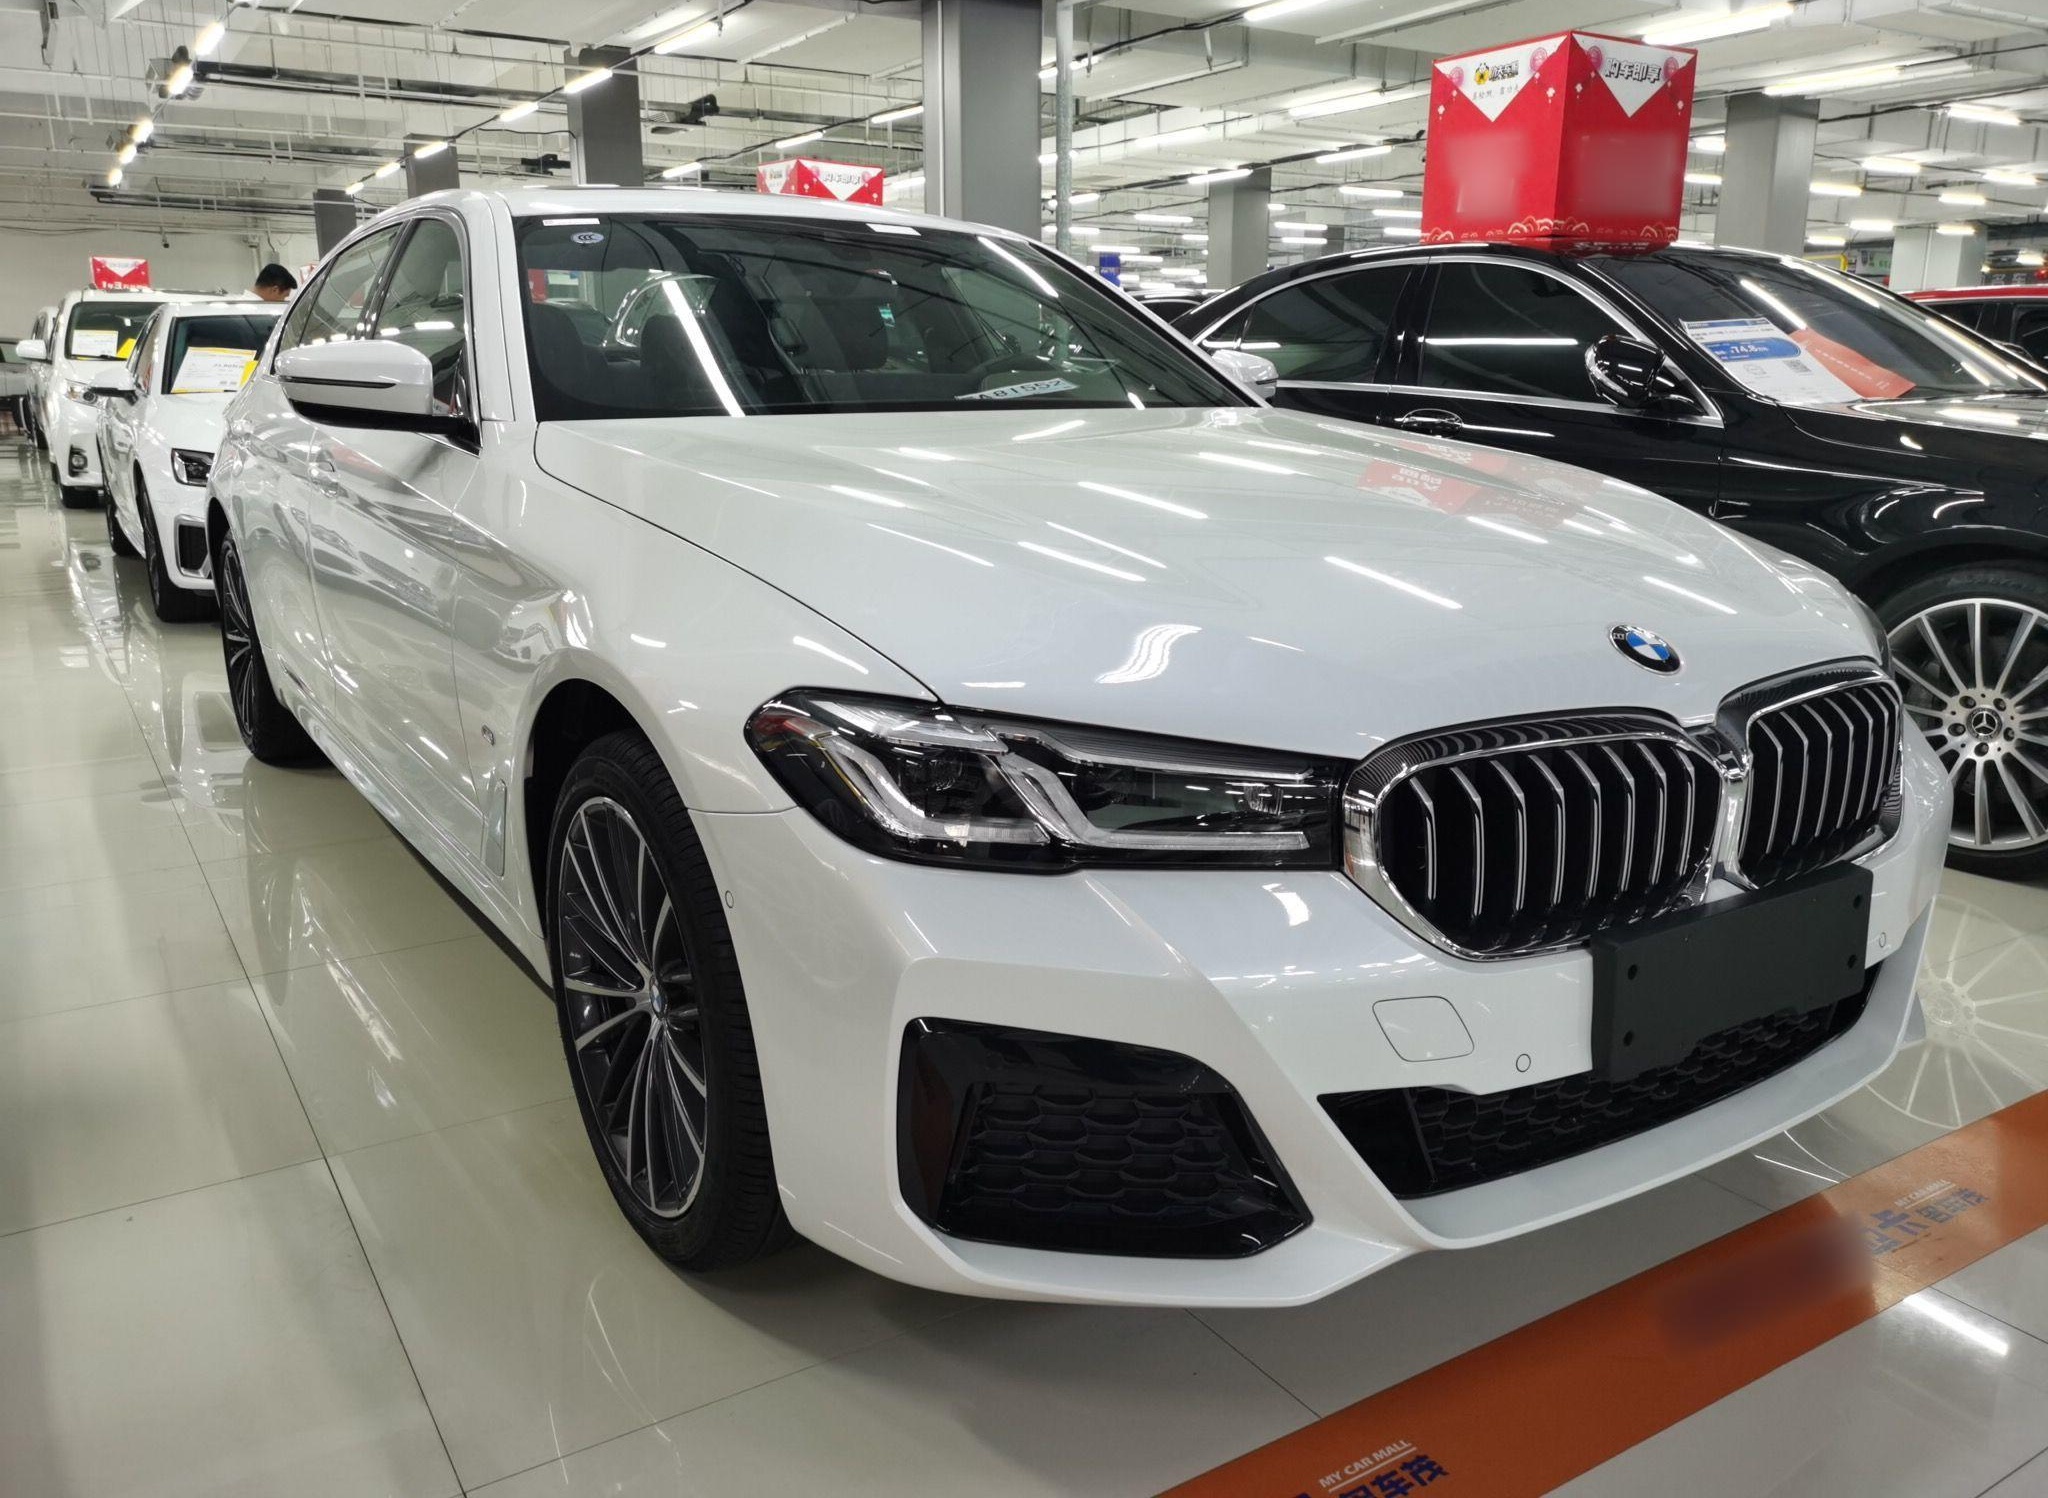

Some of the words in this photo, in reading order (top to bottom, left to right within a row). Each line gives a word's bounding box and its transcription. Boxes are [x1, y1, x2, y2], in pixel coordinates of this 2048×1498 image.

[1318, 1471, 1342, 1489] MY
[1344, 1455, 1374, 1476] CAR
[1372, 1440, 1412, 1460] MALL
